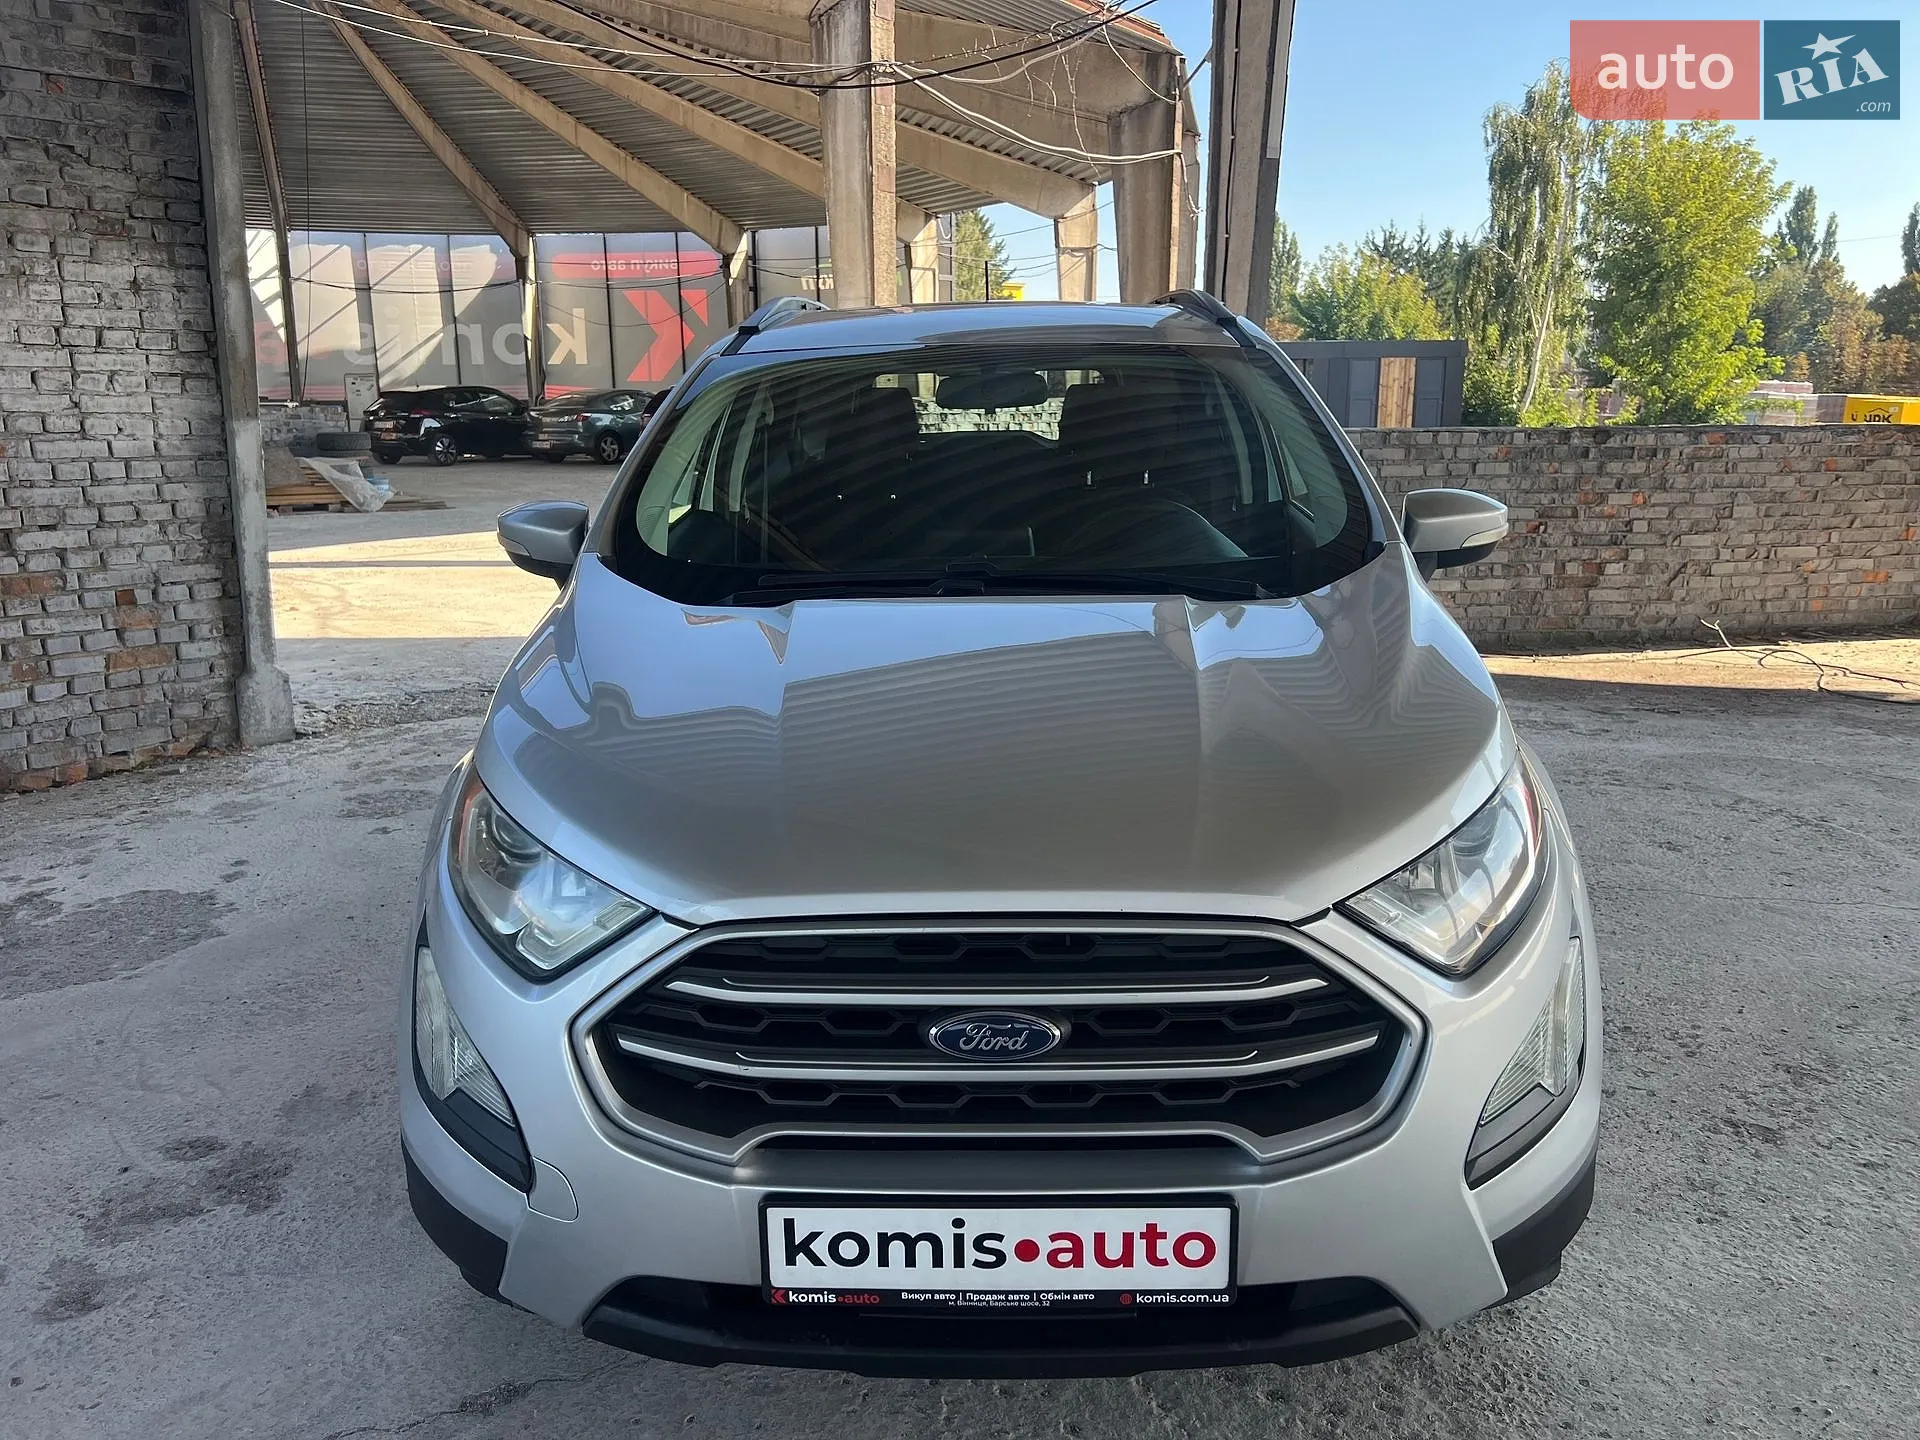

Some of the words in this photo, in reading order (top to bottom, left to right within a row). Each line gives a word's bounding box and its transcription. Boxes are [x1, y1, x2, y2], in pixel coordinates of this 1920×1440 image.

[959, 1022, 1029, 1050] Ford
[901, 1292, 932, 1301] Викуп
[966, 1292, 1006, 1302] Продаж
[1008, 1293, 1030, 1301] авто
[1040, 1292, 1071, 1301] Обмін
[1136, 1292, 1230, 1304] komis.com.ua
